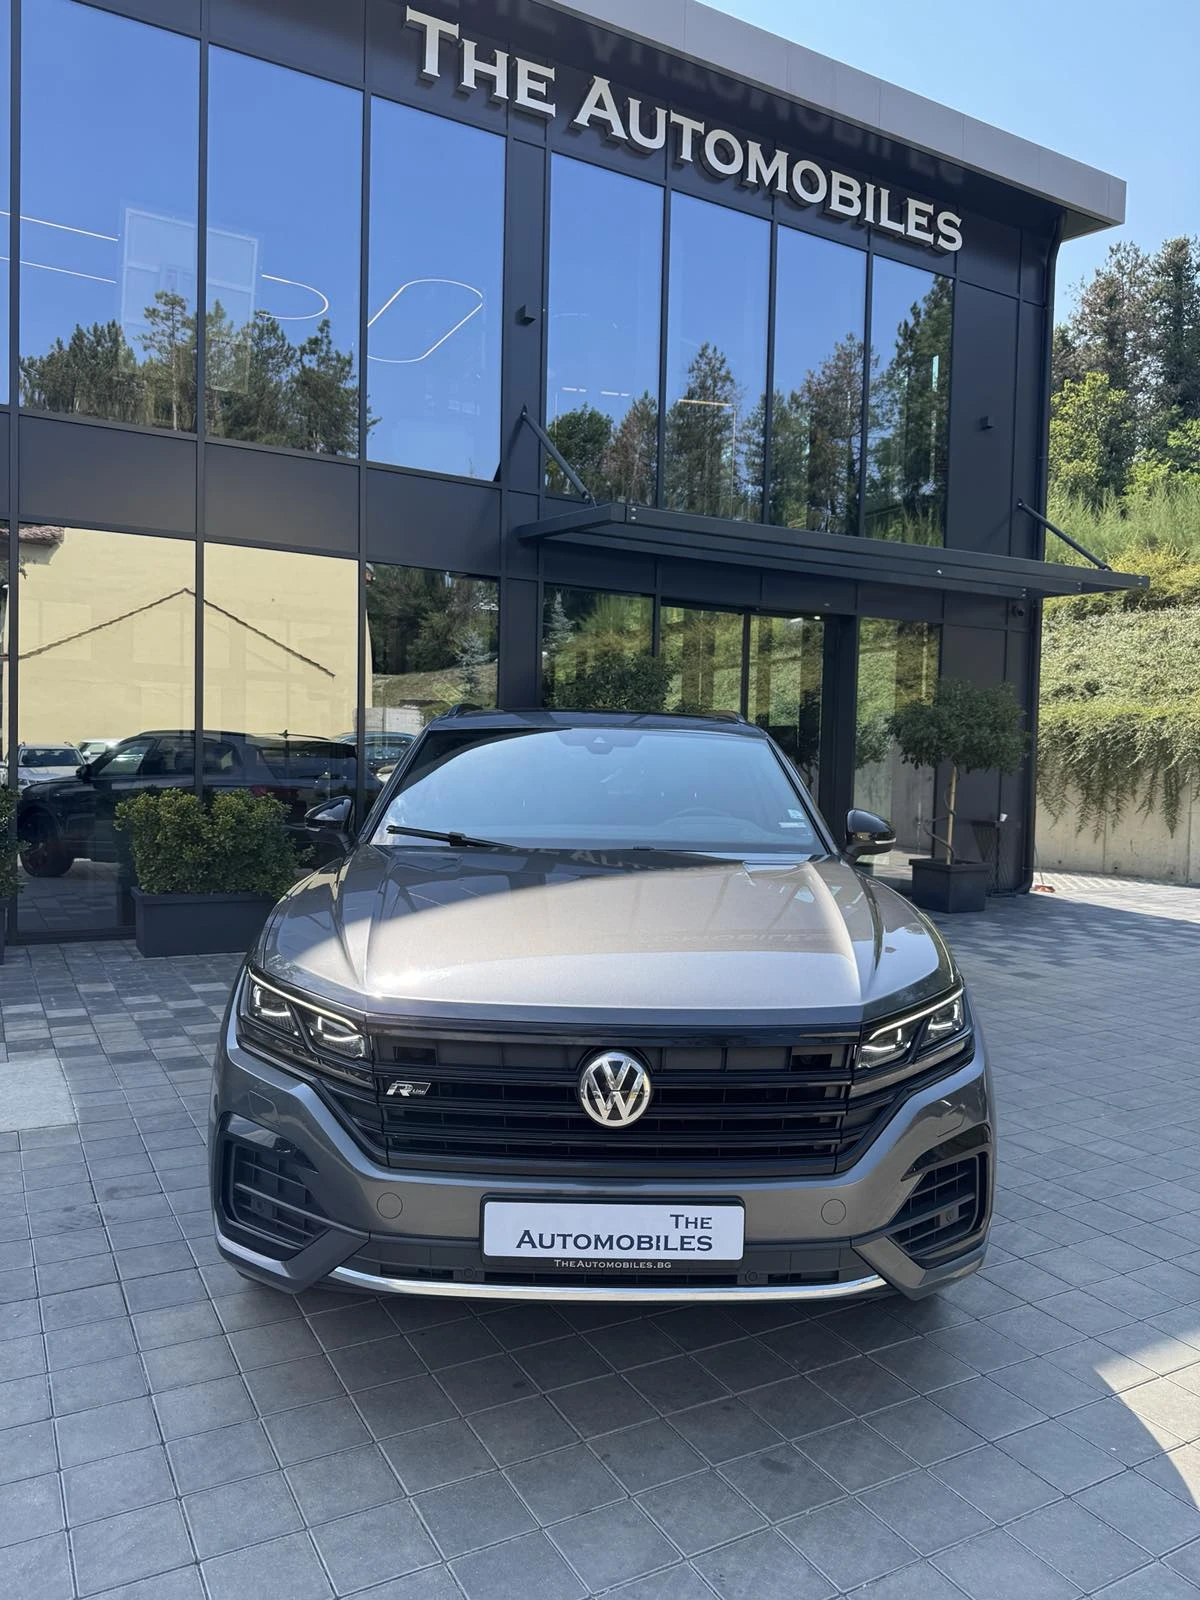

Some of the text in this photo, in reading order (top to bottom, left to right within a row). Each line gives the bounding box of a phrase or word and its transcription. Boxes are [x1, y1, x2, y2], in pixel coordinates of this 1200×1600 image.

[405, 6, 556, 118] THE
[572, 75, 964, 252] AUTOMOBILES
[583, 1053, 649, 1124] VW
[515, 1229, 714, 1252] AUTOMOBILES
[669, 1213, 713, 1230] THE
